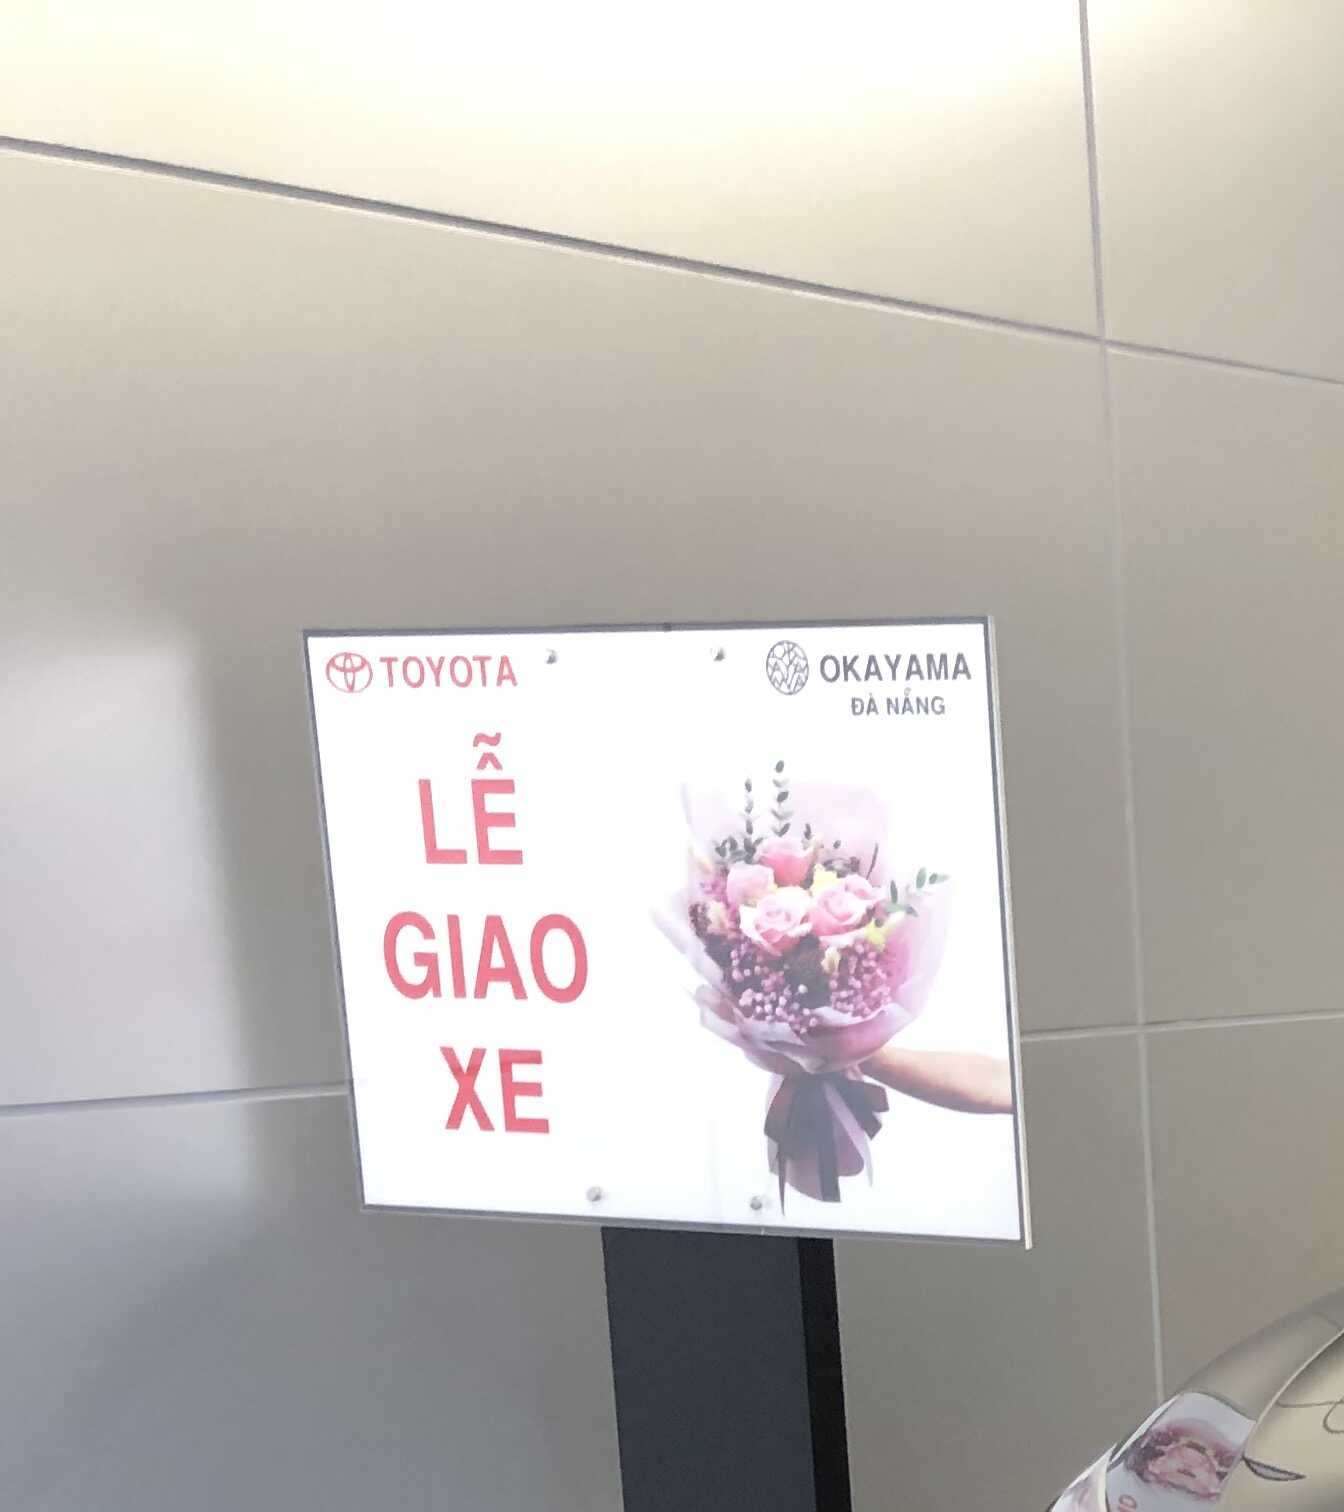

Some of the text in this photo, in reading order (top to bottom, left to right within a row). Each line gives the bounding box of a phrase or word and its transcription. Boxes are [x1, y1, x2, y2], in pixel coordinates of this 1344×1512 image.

[380, 655, 517, 688] TOYOTA
[820, 653, 971, 683] OKAYAMA
[851, 692, 879, 715] ĐÀ
[419, 732, 523, 865] LỄ
[384, 911, 588, 1003] GIAO
[440, 1046, 549, 1134] XE
